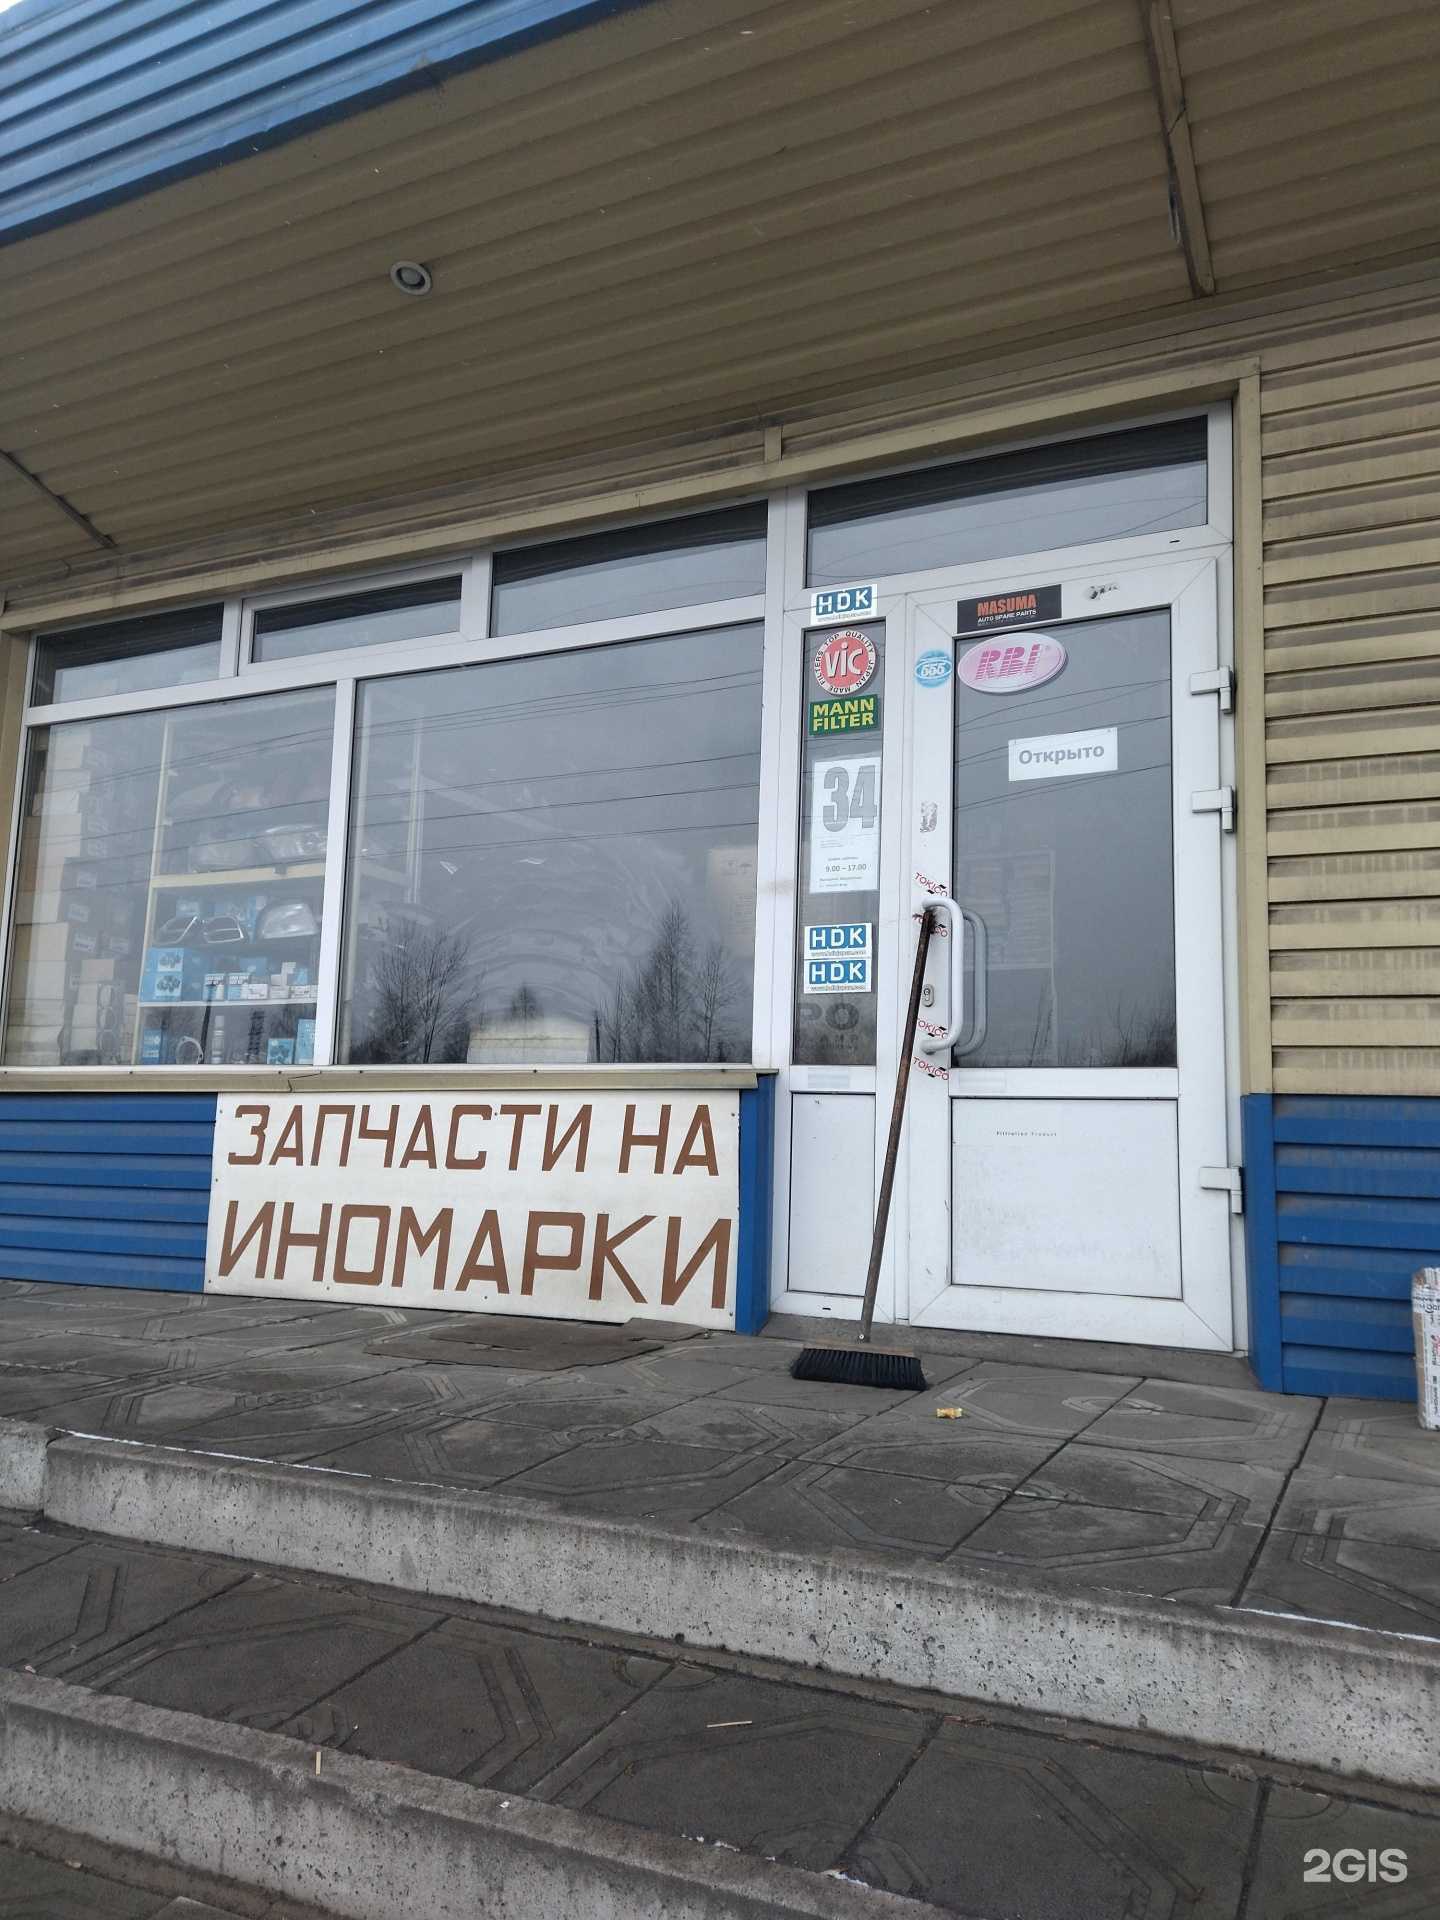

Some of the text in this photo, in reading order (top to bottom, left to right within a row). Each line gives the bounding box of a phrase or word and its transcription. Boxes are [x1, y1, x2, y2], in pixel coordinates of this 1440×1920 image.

[818, 589, 869, 614] HDK
[977, 594, 1037, 617] MASUMA
[824, 630, 874, 653] TOP QUALITY
[813, 697, 875, 718] MANN
[813, 712, 875, 732] FILTER
[1018, 744, 1106, 767] Открыто
[822, 764, 878, 833] 34
[914, 872, 948, 897] TOKICO
[812, 927, 864, 948] HDK
[811, 962, 864, 982] HDK
[917, 1019, 949, 1040] OKICO
[913, 1056, 950, 1081] TOKICO
[227, 1103, 720, 1177] ЗАПЧАСТИ НА
[218, 1199, 733, 1310] ИНОМАРКИ
